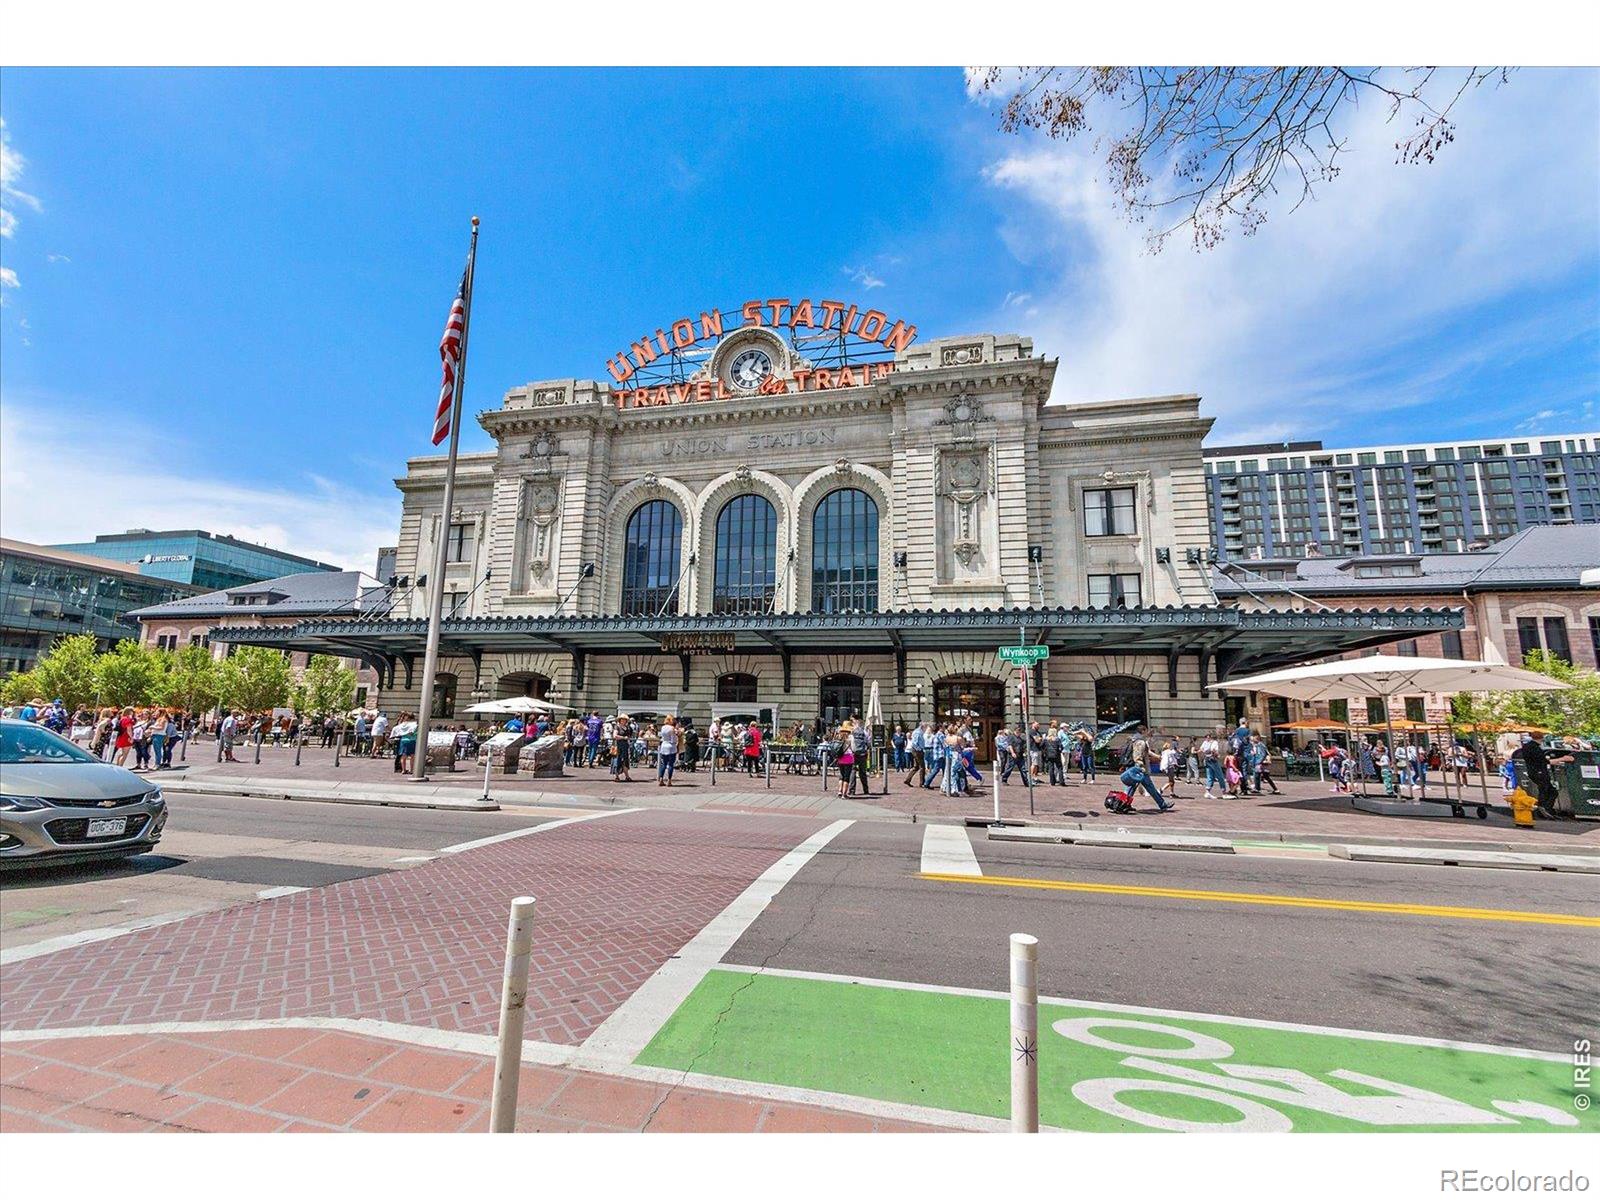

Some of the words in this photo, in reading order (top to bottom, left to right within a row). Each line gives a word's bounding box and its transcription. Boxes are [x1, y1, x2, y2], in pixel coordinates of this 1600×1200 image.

[606, 308, 723, 382] UNION
[743, 299, 916, 352] STATION
[614, 377, 733, 409] TRAVEL
[793, 361, 896, 392] TRAIN
[661, 438, 728, 457] UNION
[747, 427, 836, 450] STATION
[1001, 647, 1039, 657] Wynkoop
